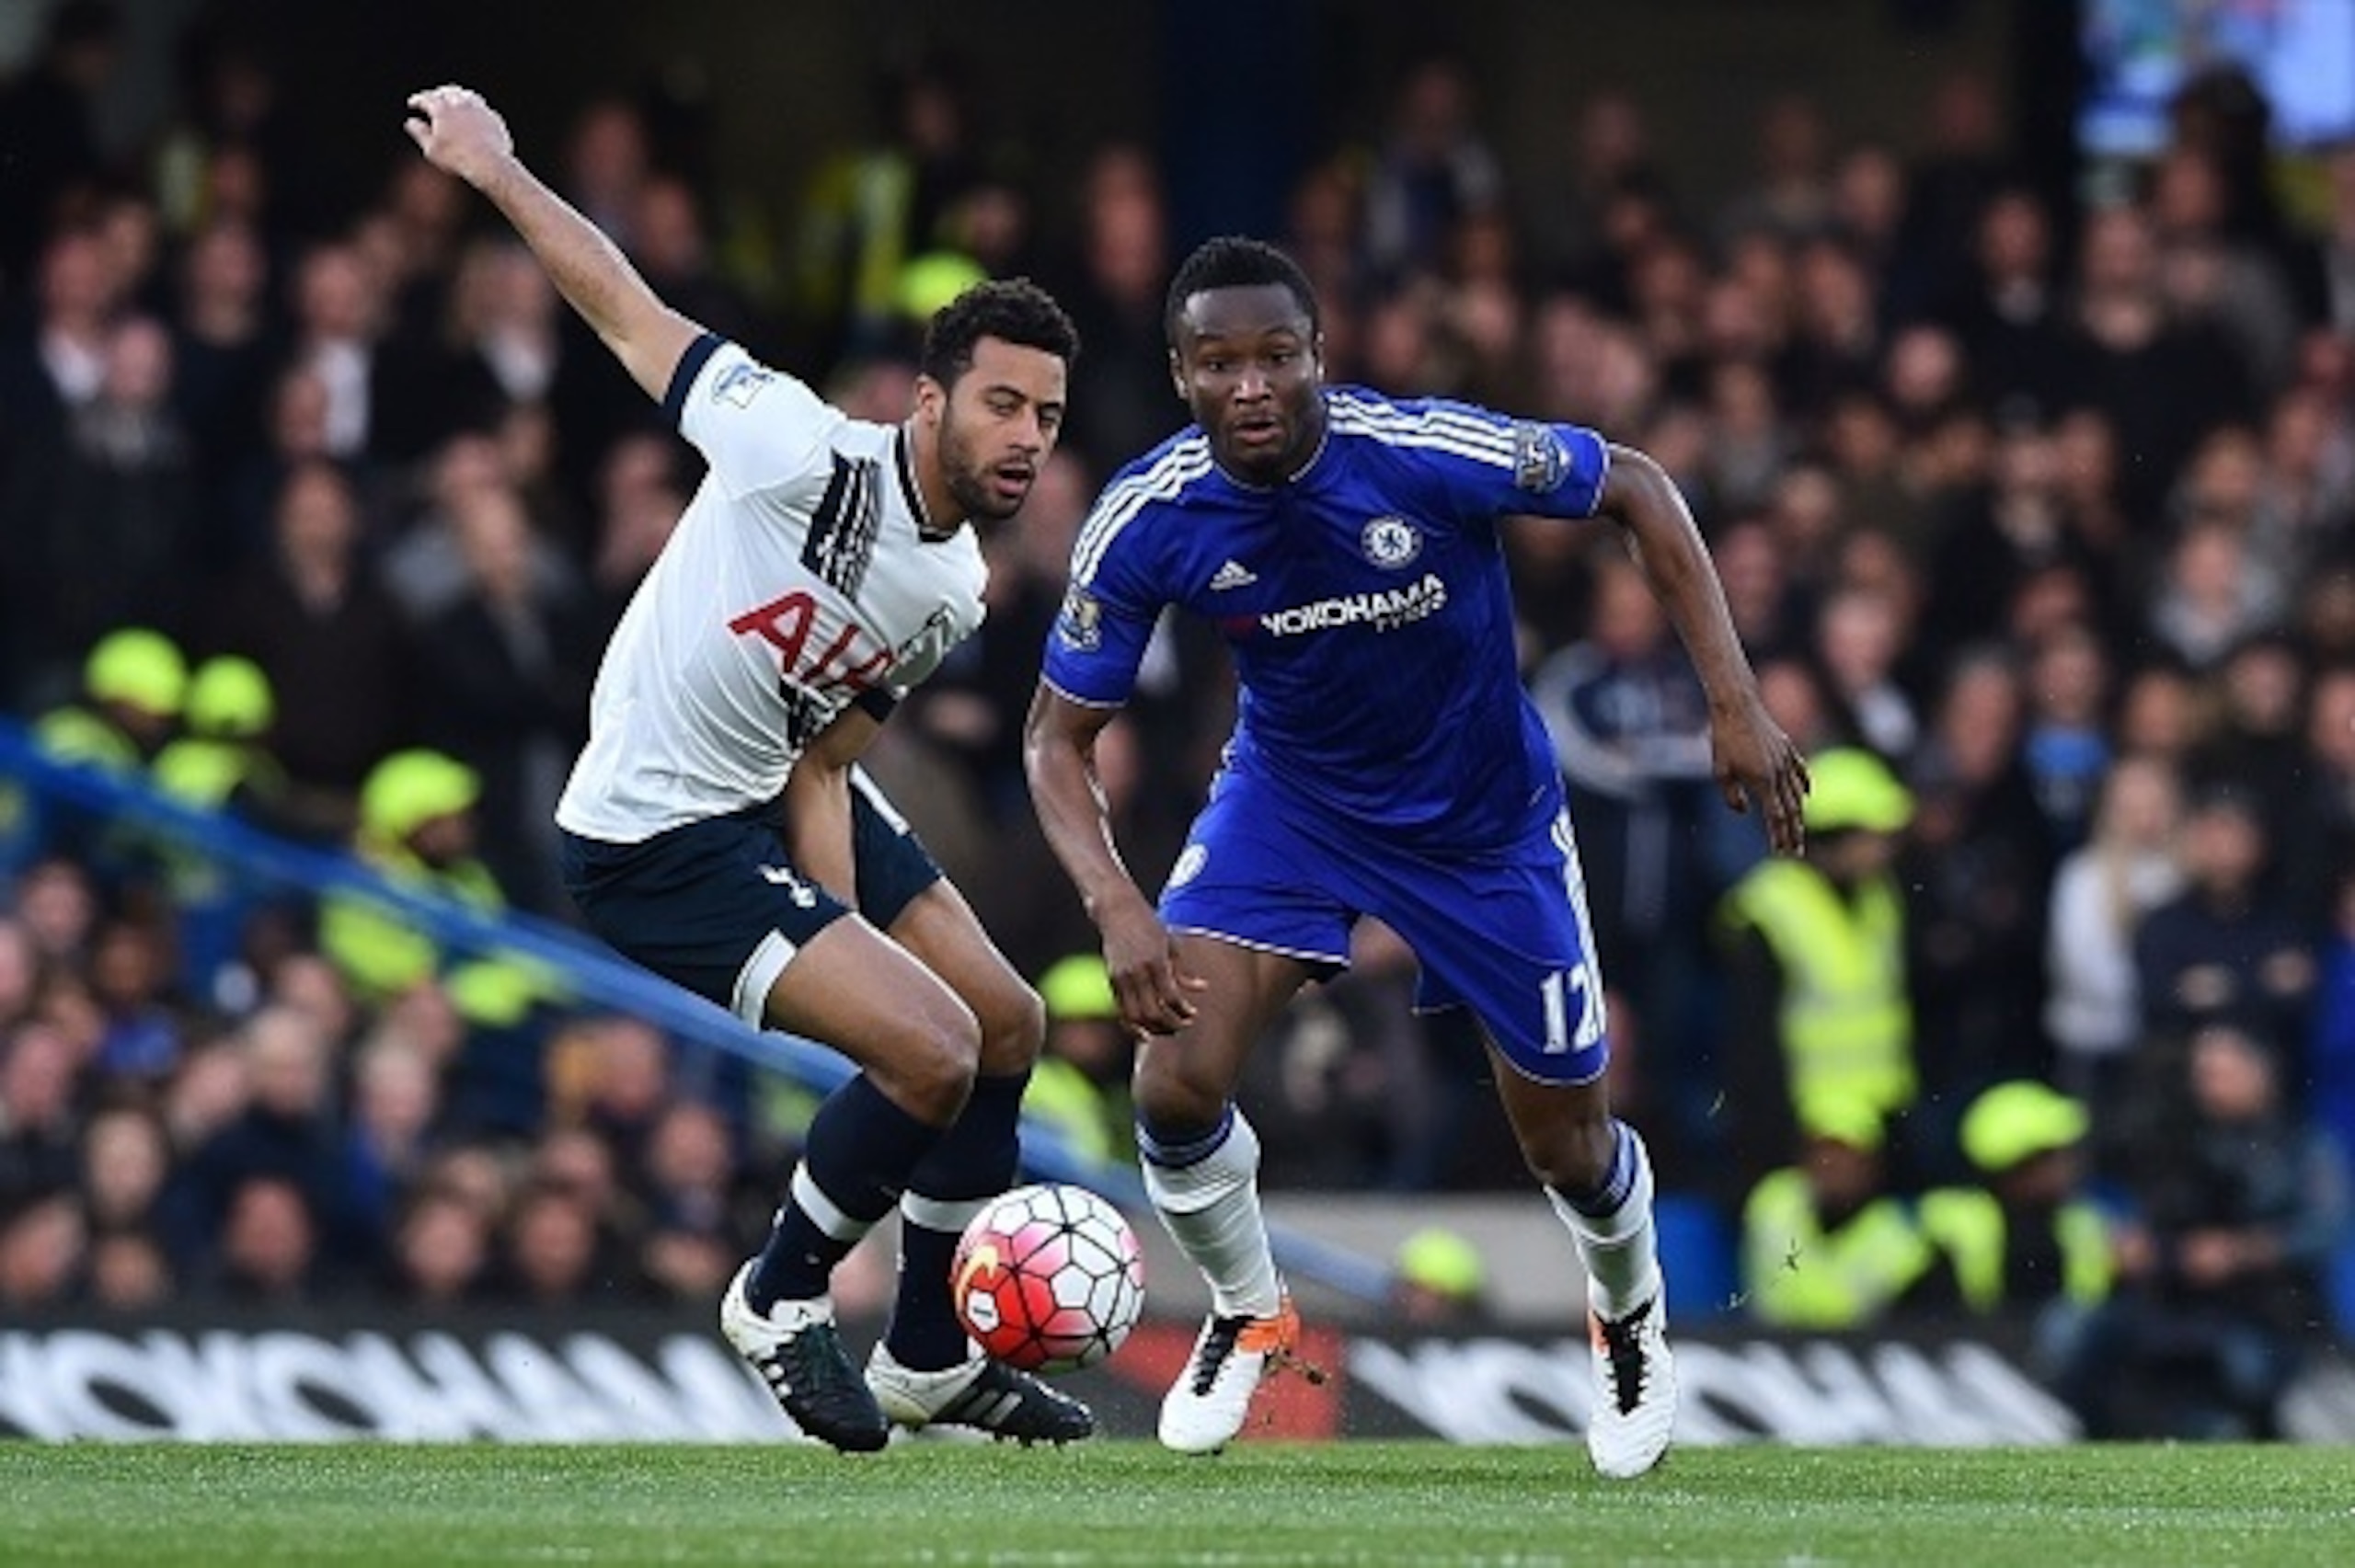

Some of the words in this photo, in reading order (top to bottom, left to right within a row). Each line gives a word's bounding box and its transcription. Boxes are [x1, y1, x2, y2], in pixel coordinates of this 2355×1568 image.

[1260, 573, 1443, 636] YOKOHAMA
[1539, 962, 1601, 1054] 12
[0, 1328, 883, 1445] YOKOHAM
